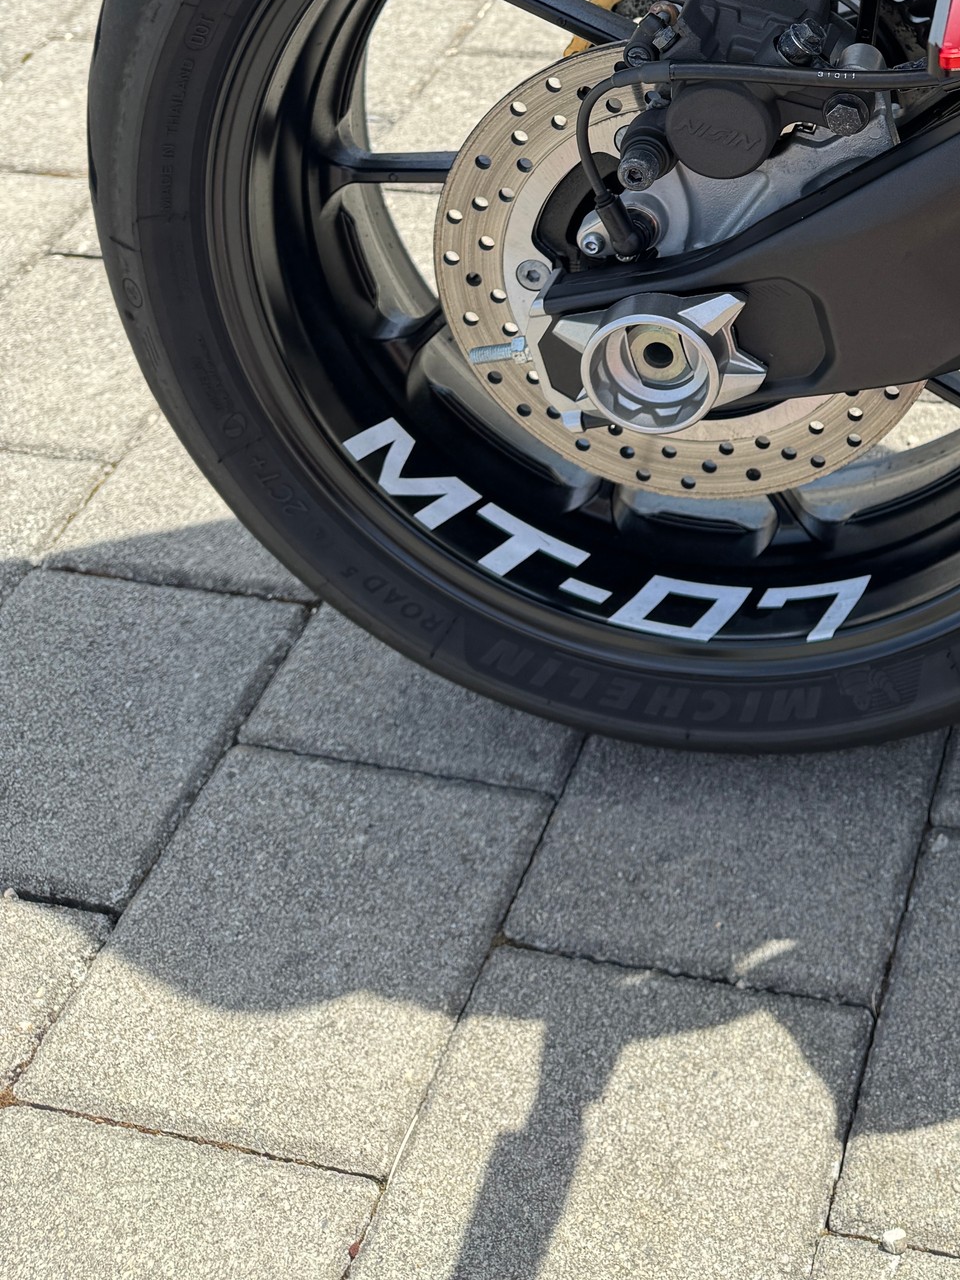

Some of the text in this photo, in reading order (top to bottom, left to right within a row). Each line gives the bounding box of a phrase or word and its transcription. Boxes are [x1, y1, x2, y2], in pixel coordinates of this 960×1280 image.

[160, 58, 195, 210] MADE IN THAILAND
[249, 457, 309, 516] 2CT+
[342, 418, 871, 642] MT-07
[340, 566, 444, 632] ROAD 5
[479, 639, 822, 723] MICHELIN
